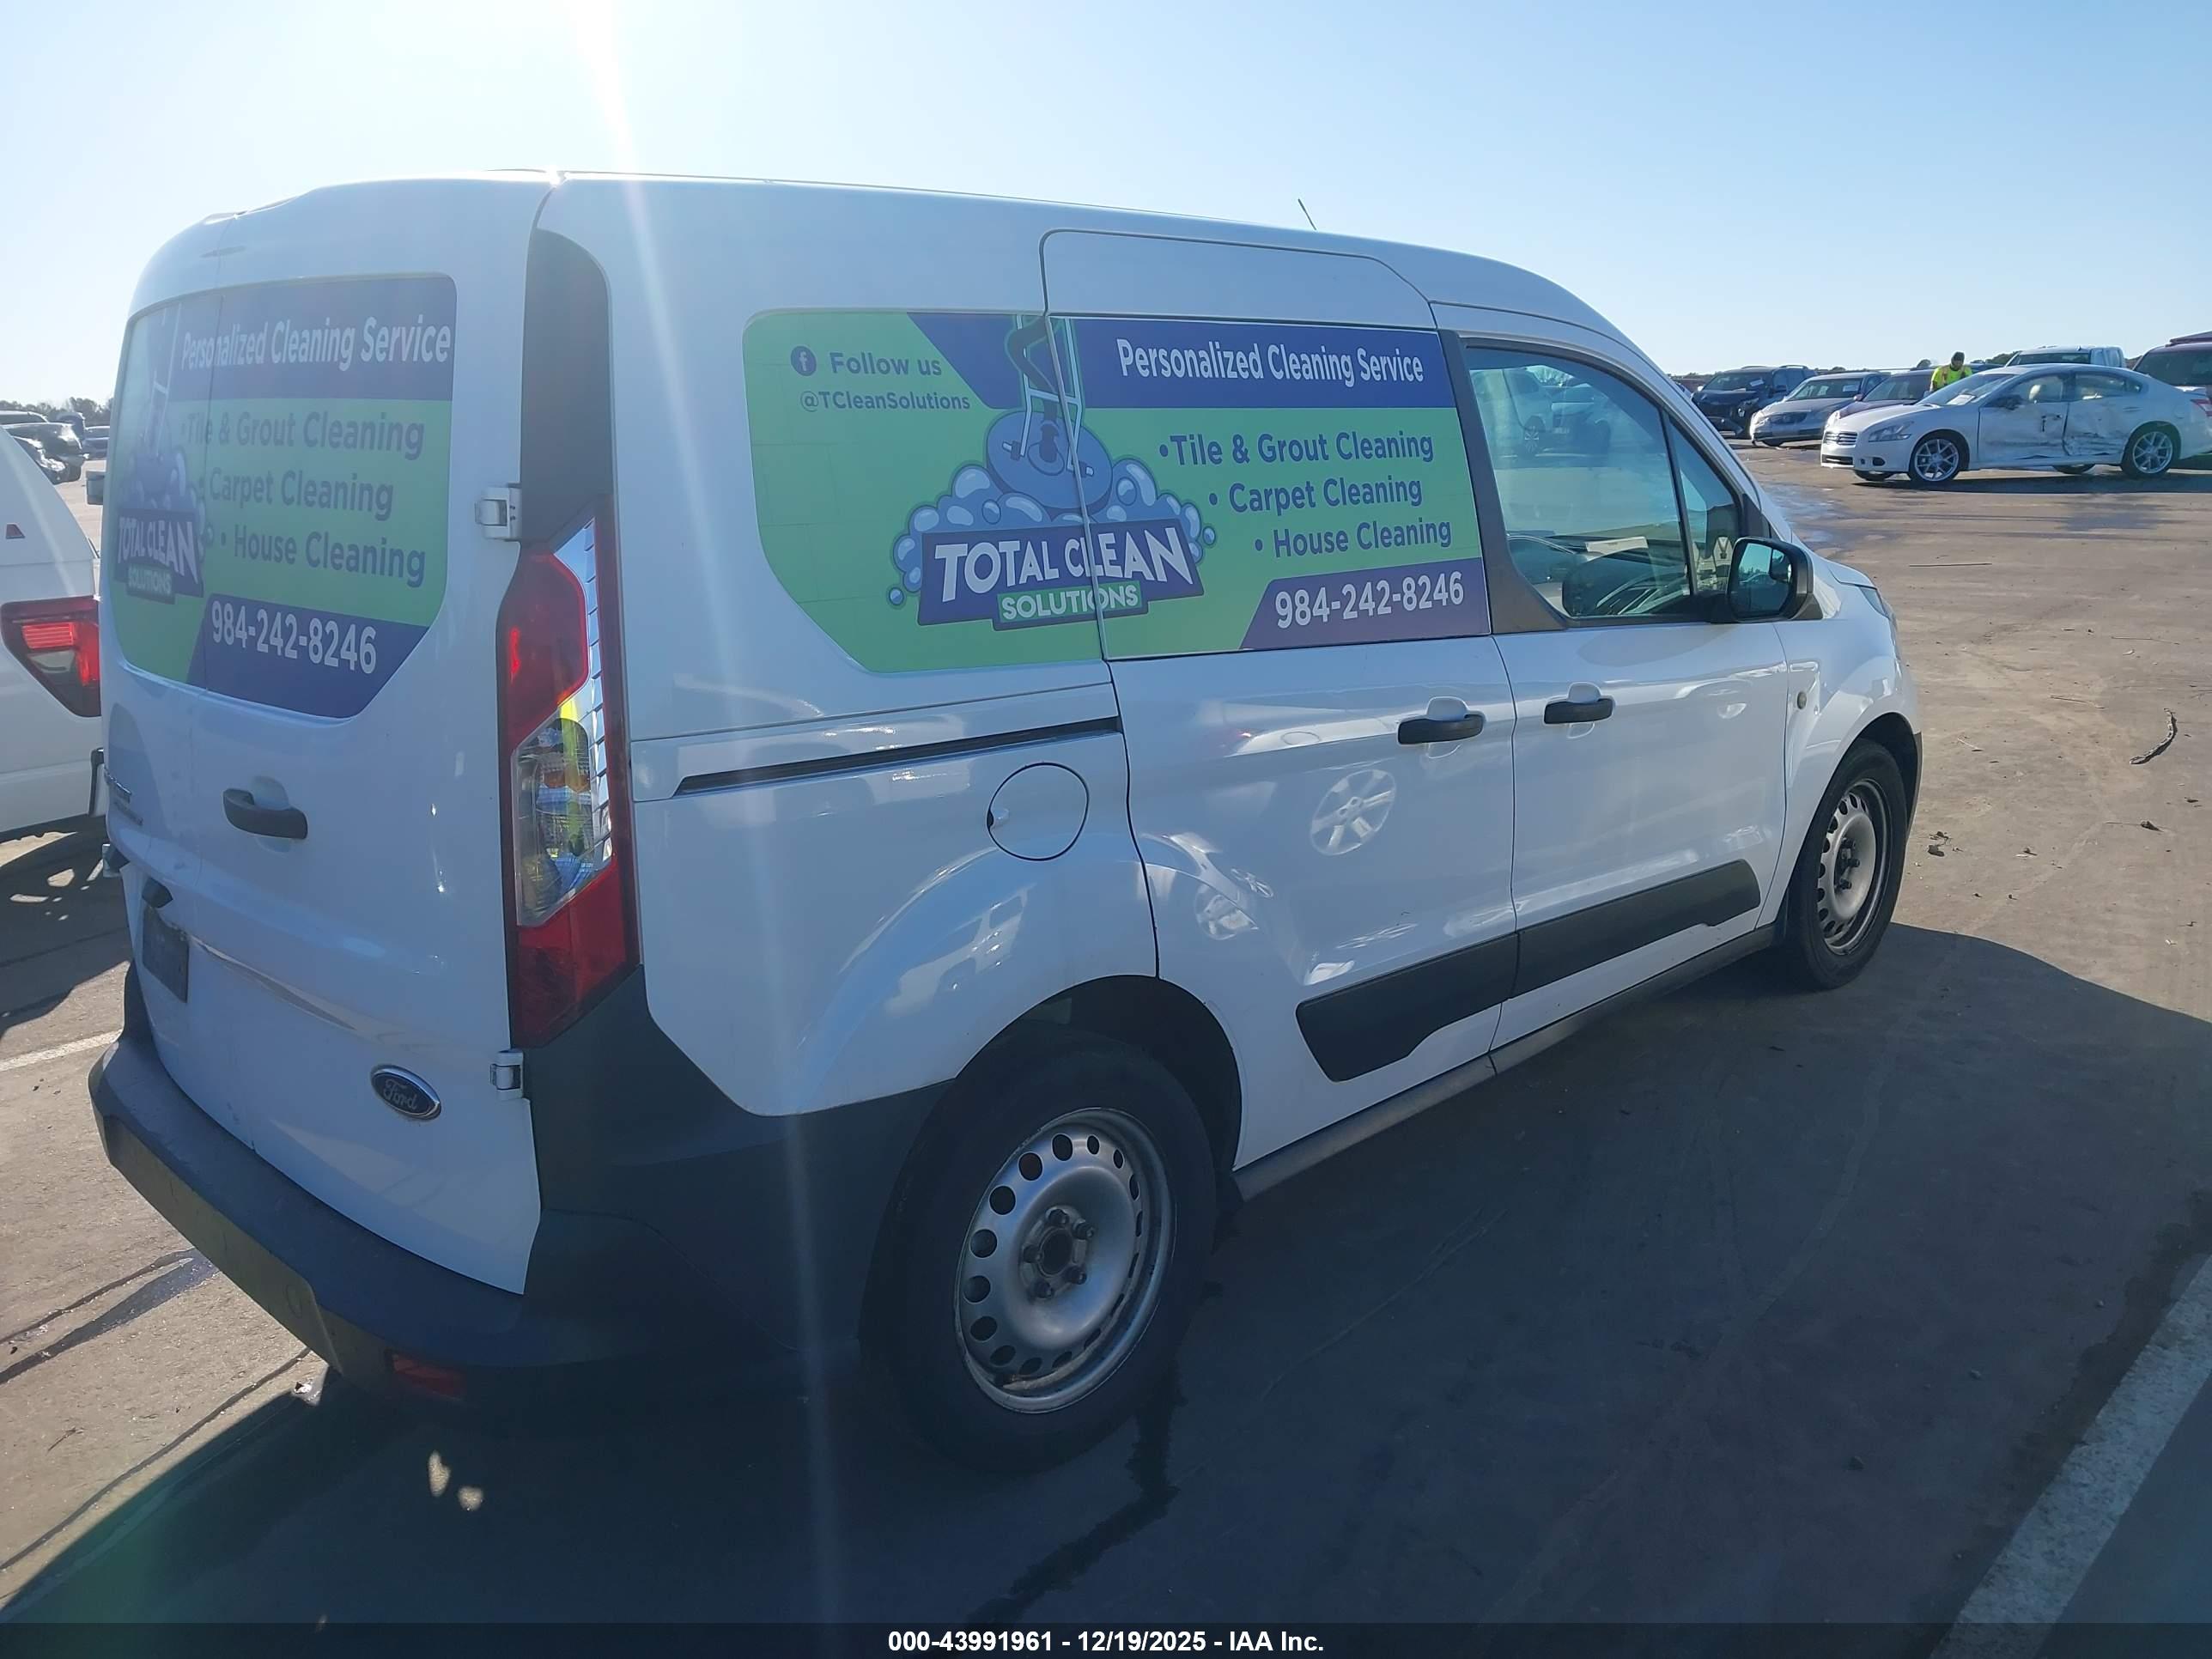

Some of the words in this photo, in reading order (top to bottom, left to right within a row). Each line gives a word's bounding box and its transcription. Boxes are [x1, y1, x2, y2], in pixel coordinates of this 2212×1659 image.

[181, 322, 269, 371] Personalized
[271, 318, 356, 372] Cleaning
[361, 314, 452, 364] Service
[830, 352, 909, 375] Follow
[917, 356, 942, 376] us
[1117, 338, 1264, 380] Personalized
[1267, 343, 1354, 387] Cleaning
[1358, 345, 1424, 382] Service
[799, 391, 970, 412] @TCleanSolutions
[237, 411, 296, 447] Grout
[303, 411, 425, 461] Cleaning
[1170, 434, 1223, 465] Tile
[1231, 434, 1250, 464] &
[1257, 433, 1329, 463] Grout
[1335, 430, 1434, 463] Cleaning
[210, 467, 273, 509] Carpet
[281, 470, 394, 521] Cleaning
[1229, 480, 1316, 516] Carpet
[1323, 476, 1423, 507] Cleaning
[146, 520, 198, 584] CLEAN
[234, 525, 297, 565] House
[305, 532, 426, 588] Cleaning
[1273, 527, 1349, 558] House
[1357, 517, 1451, 549] Cleaning
[934, 541, 1060, 603] TOTAL
[1064, 527, 1194, 585] CLEAN
[1001, 585, 1139, 620] SOLUTIONS
[1275, 571, 1464, 629] 984-242-8246
[211, 601, 377, 675] 984-242-8246
